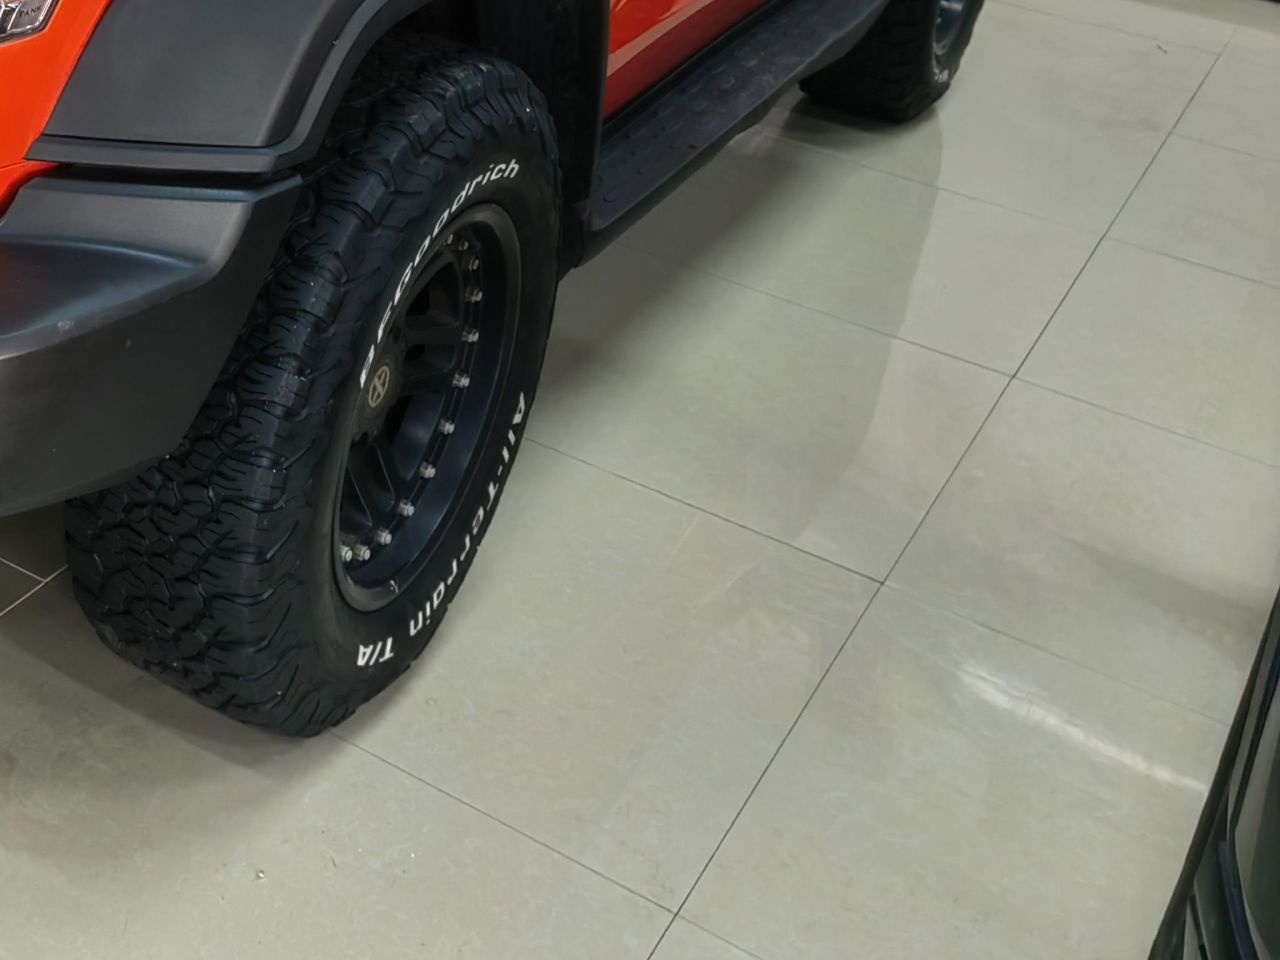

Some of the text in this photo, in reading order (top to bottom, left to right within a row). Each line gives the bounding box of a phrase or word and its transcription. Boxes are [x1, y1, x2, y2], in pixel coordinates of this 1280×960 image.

[360, 158, 520, 389] BFGoodrich
[356, 391, 526, 669] All-Terrain T/A
